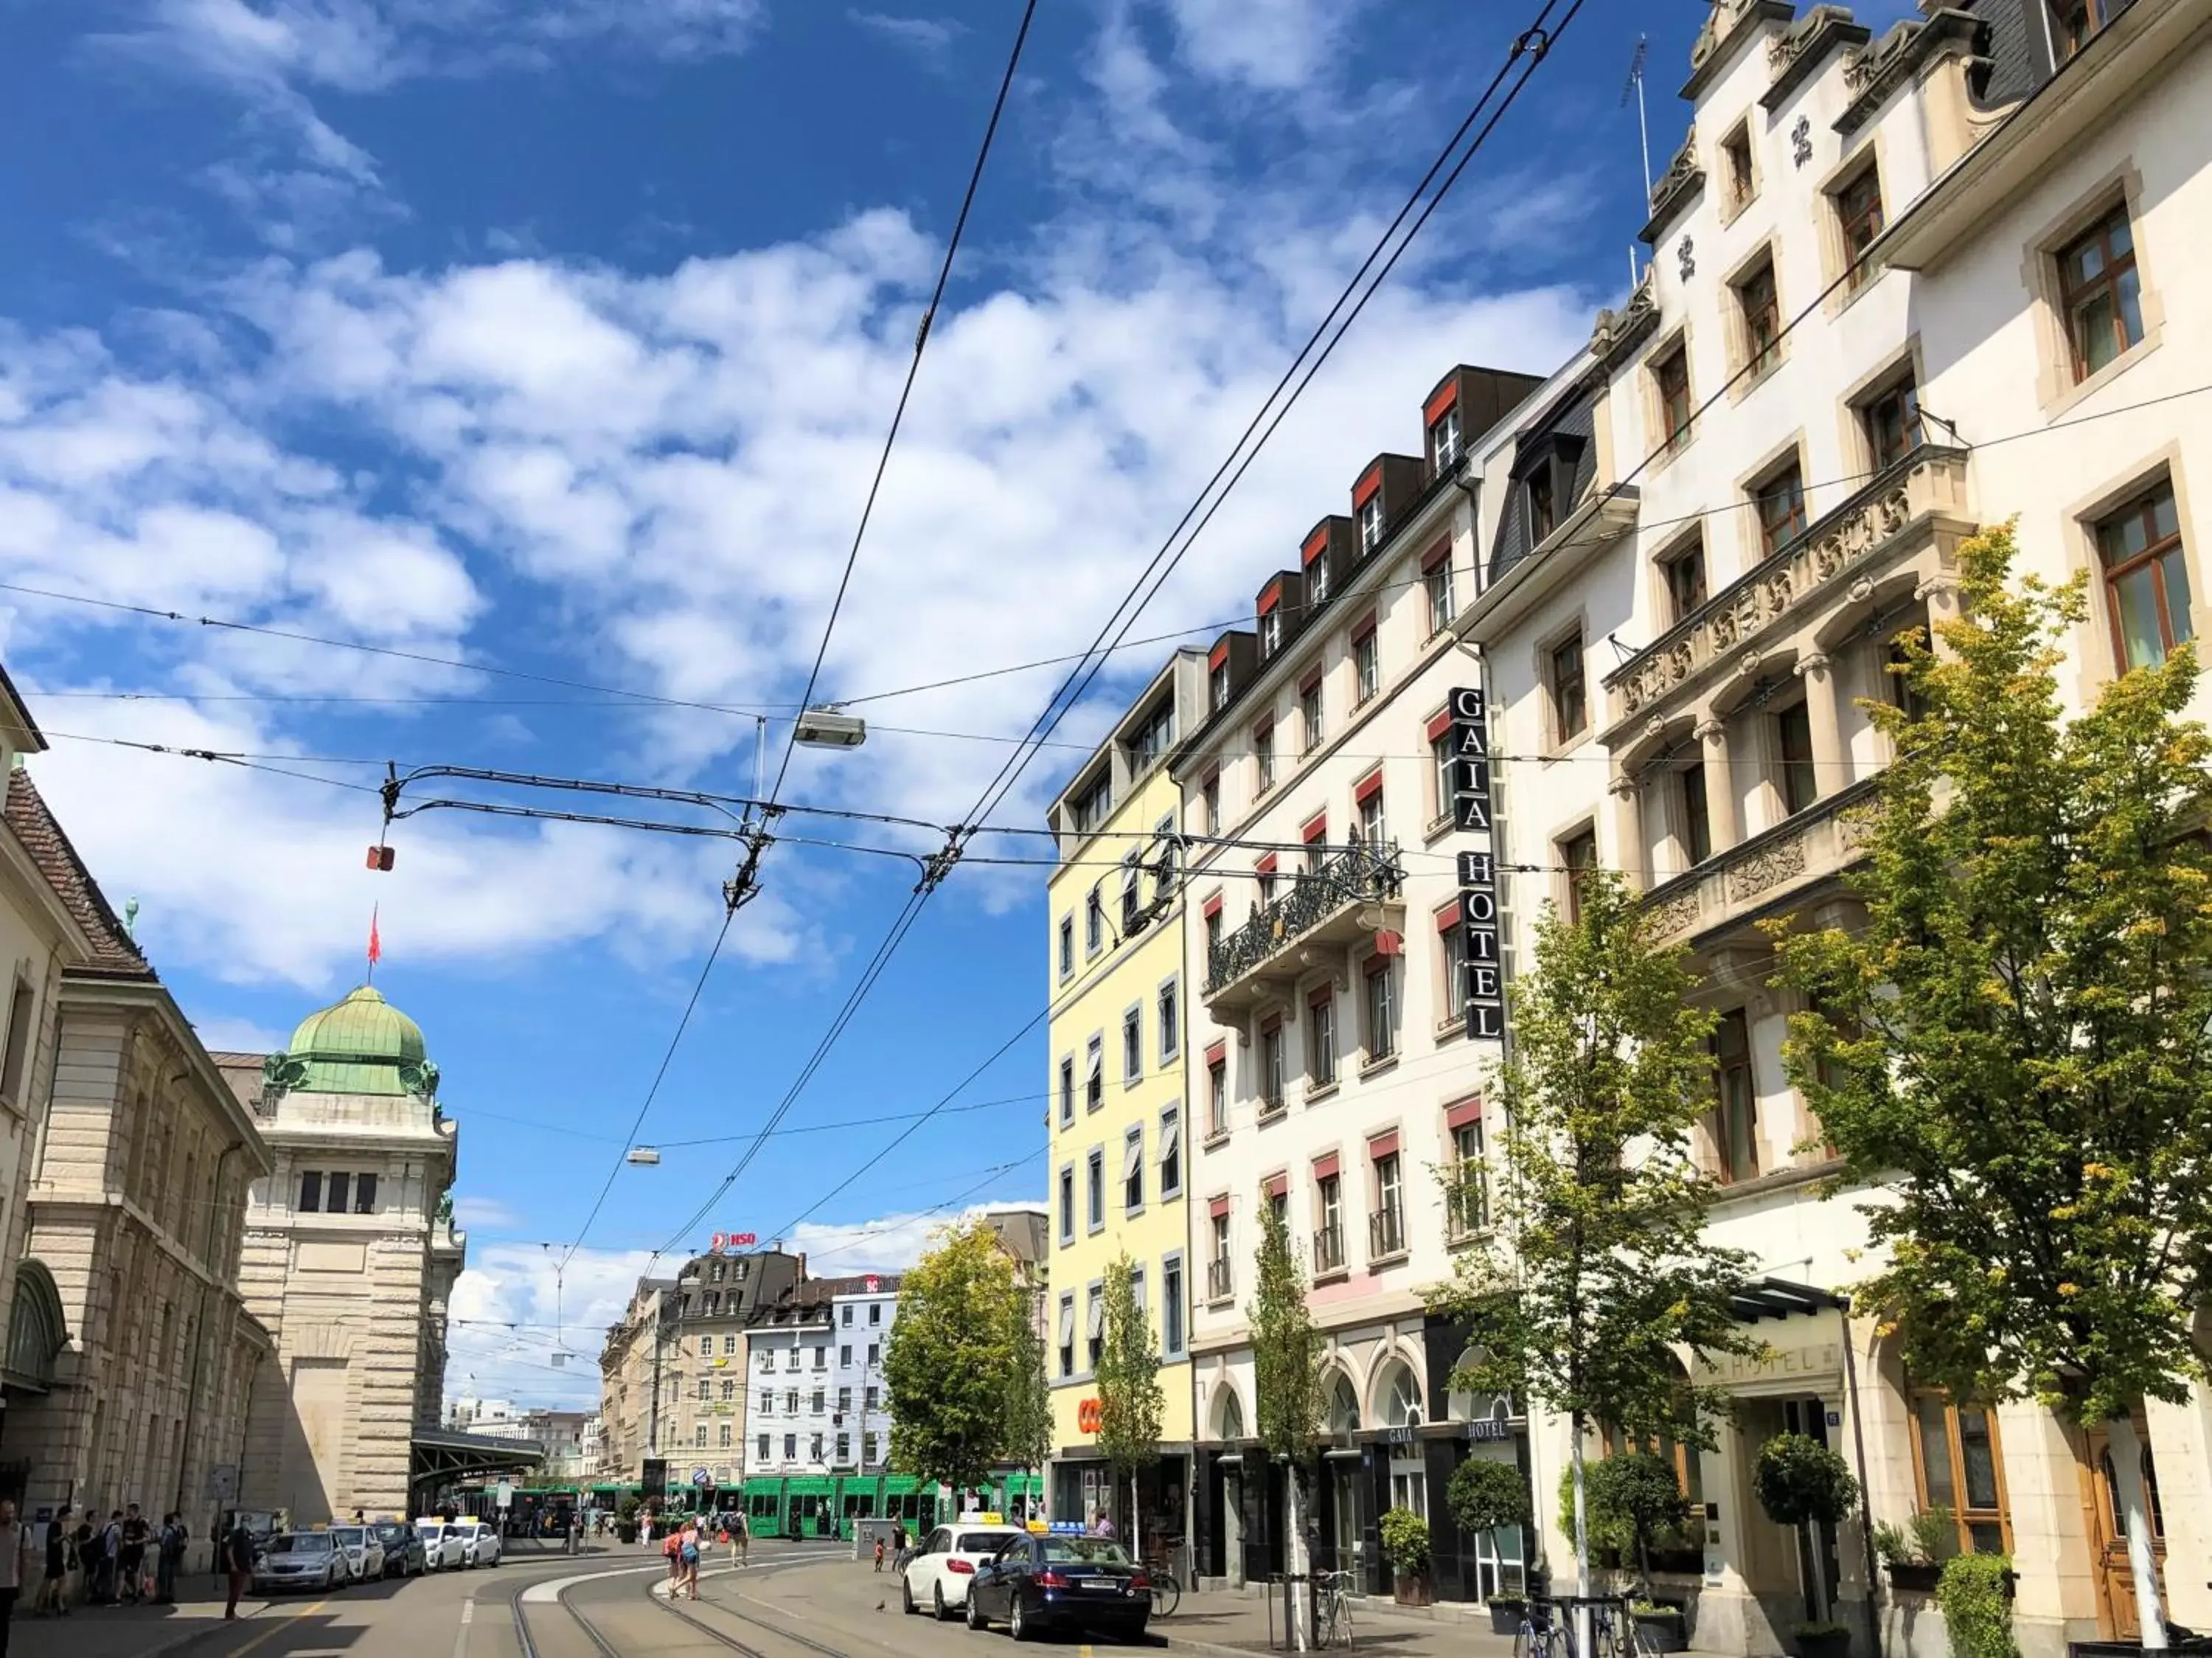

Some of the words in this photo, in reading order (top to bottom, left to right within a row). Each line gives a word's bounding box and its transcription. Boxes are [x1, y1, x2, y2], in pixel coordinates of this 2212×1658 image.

[1457, 690, 1489, 828] GAIA
[1467, 853, 1500, 1036] HOTEL
[1388, 1428, 1413, 1443] GAIA
[1468, 1421, 1505, 1438] HOTEL
